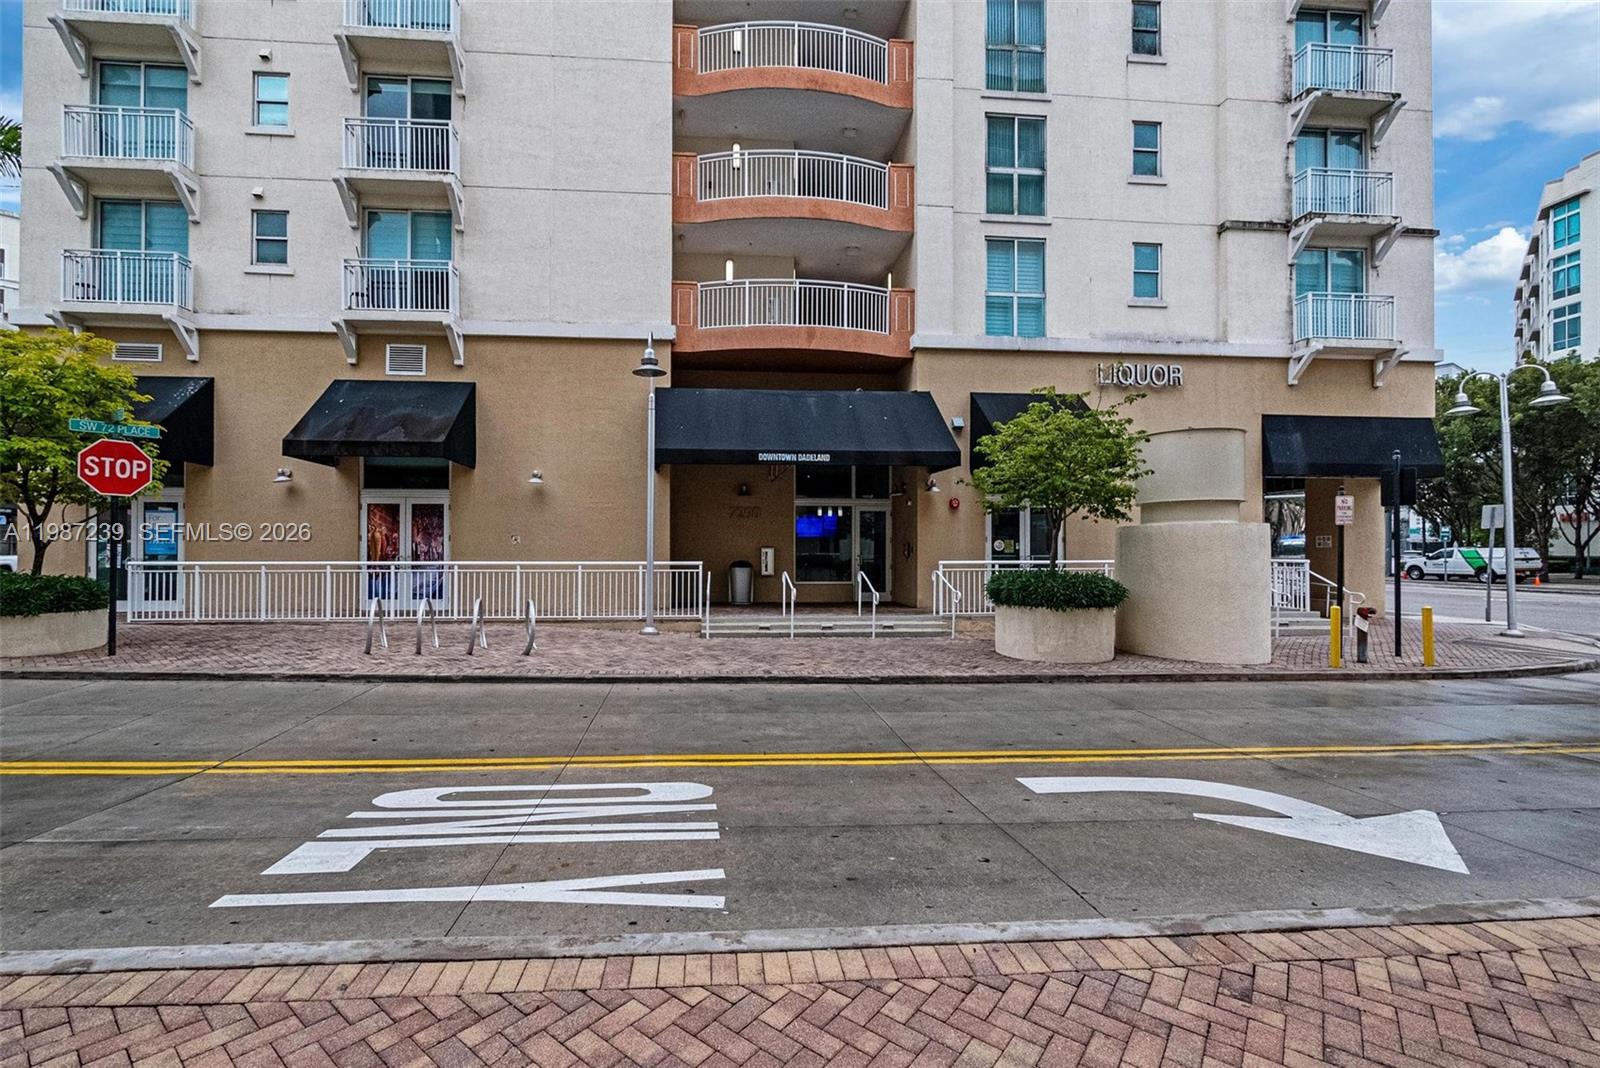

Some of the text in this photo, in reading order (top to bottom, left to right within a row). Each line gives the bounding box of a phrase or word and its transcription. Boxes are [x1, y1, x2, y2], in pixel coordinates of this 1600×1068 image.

[1097, 363, 1184, 386] LIQUOR
[79, 421, 151, 436] SW 72 PLACE
[84, 456, 147, 479] STOP
[758, 453, 831, 462] DOWNTOWN DADELAND
[208, 782, 727, 909] ONLY
